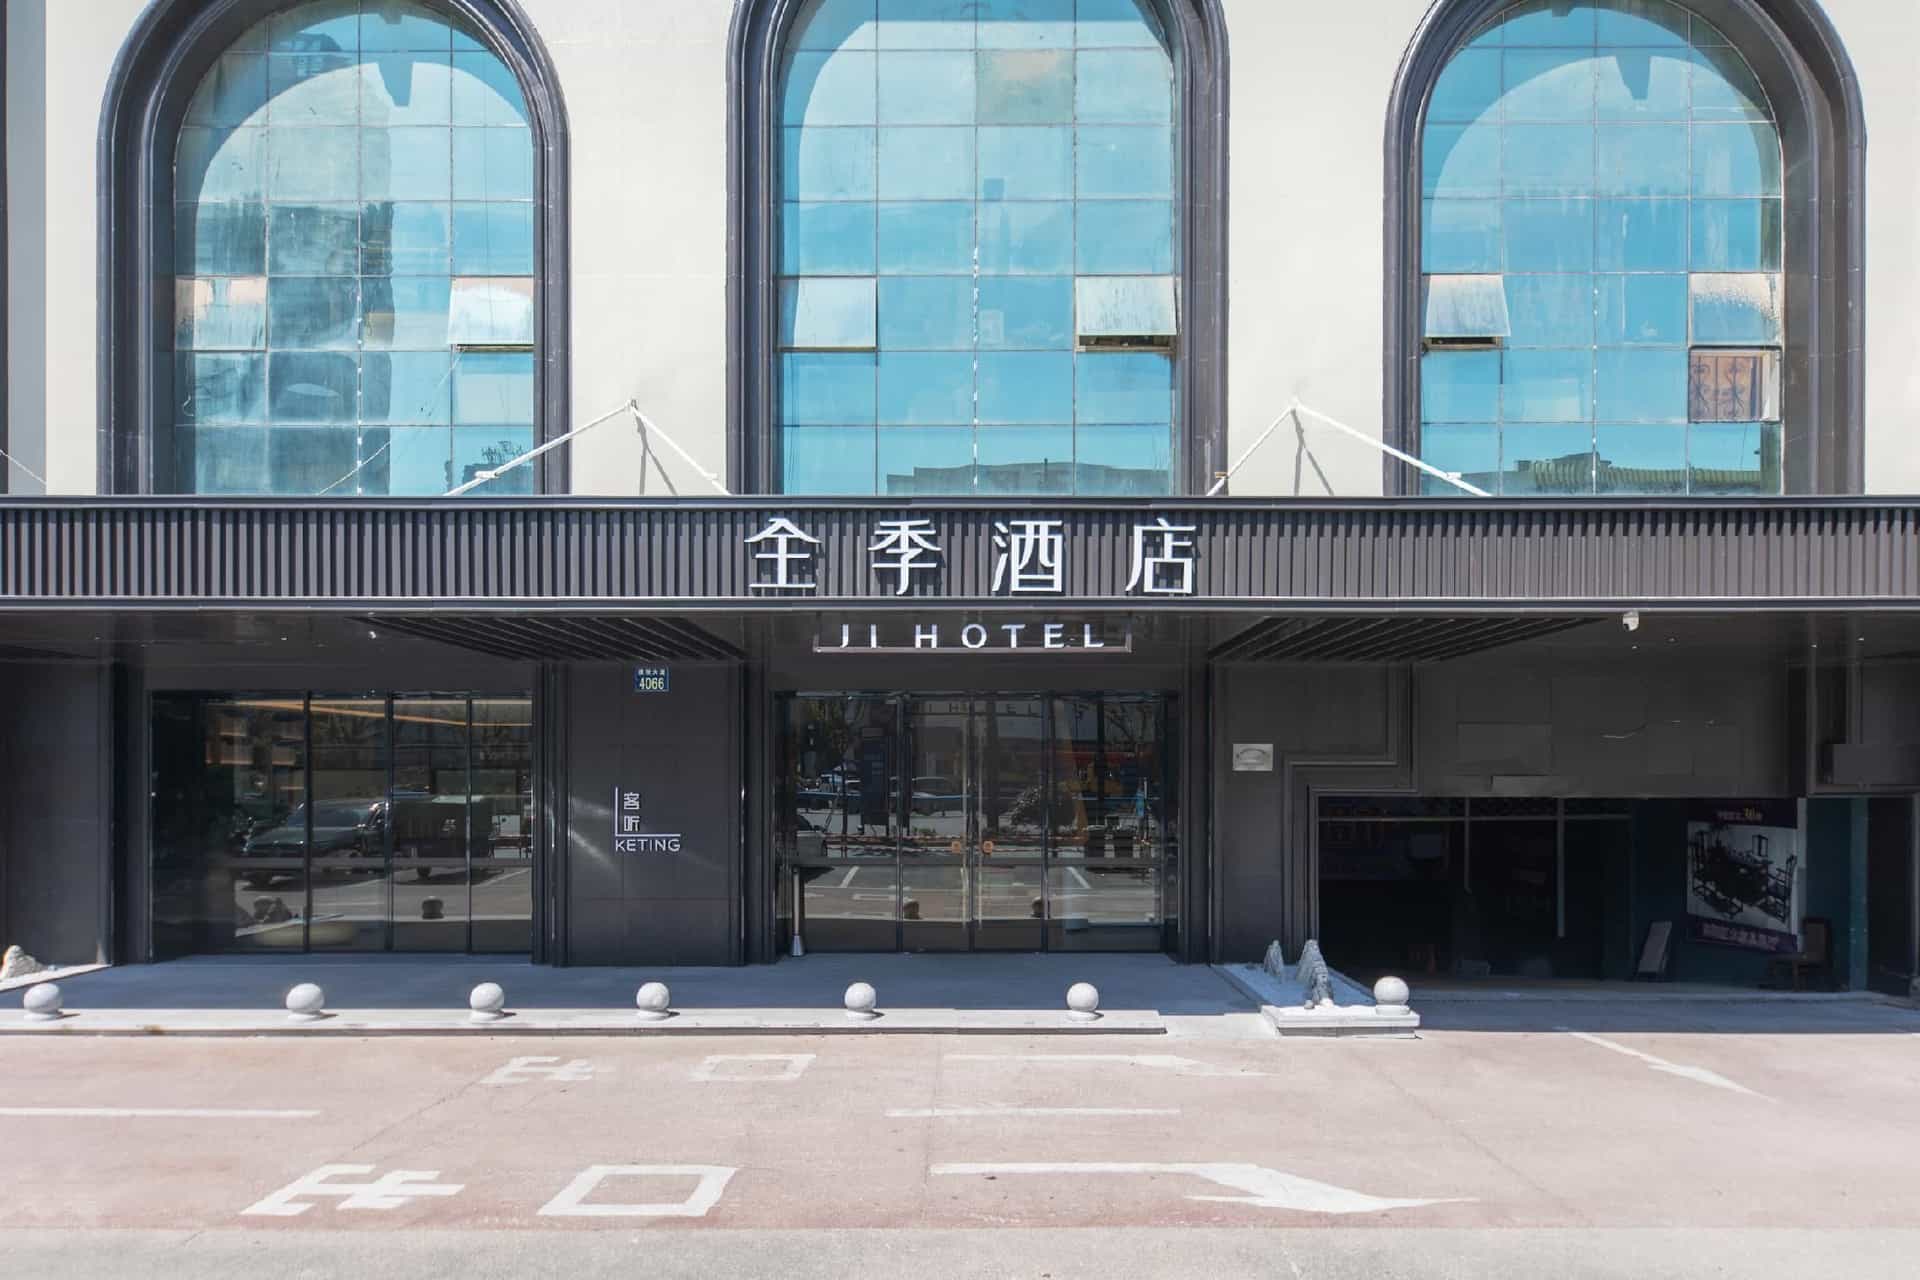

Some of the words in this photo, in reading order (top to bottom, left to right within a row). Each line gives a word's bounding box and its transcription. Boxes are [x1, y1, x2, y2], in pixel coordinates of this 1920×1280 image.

[744, 517, 1197, 595] 全季酒店
[838, 623, 878, 650] JI
[914, 623, 1105, 650] HOTEL
[639, 677, 665, 690] 4066
[615, 838, 681, 852] KETING
